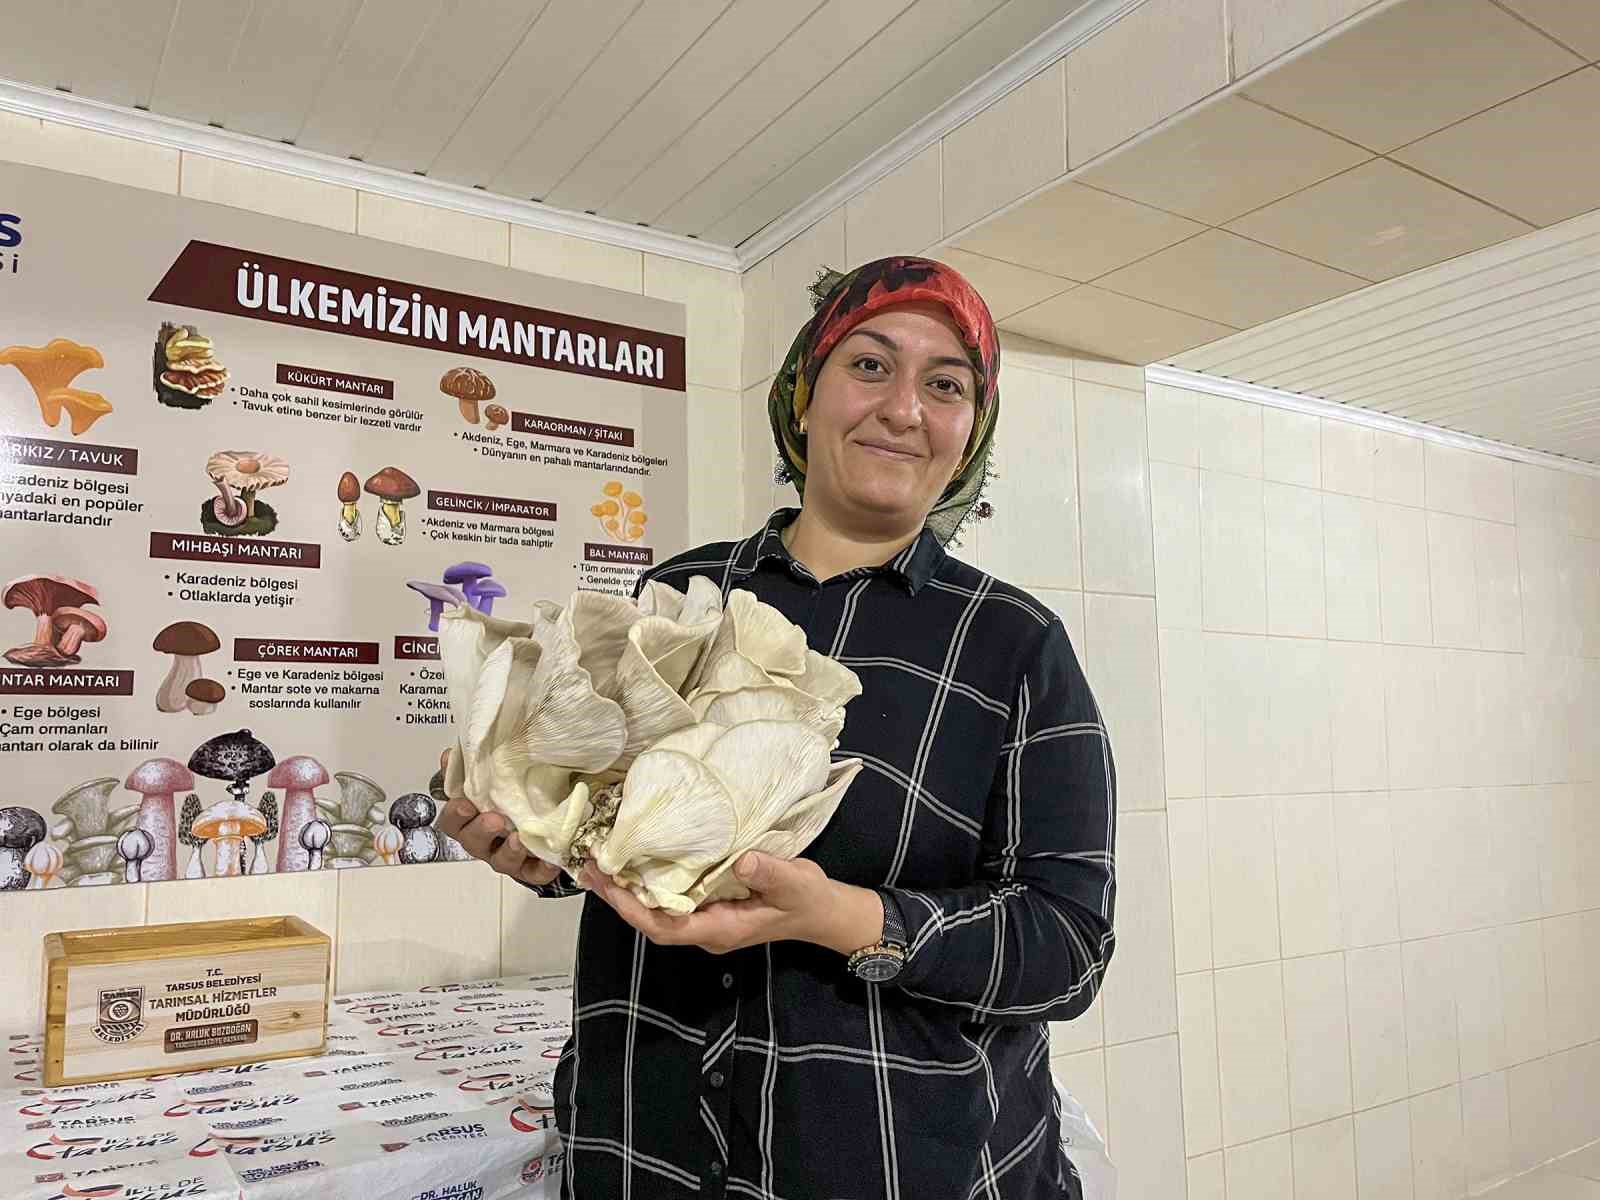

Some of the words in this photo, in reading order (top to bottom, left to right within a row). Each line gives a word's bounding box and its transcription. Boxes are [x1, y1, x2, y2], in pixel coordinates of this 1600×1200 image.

[237, 261, 448, 343] ÜLKEMİZİN
[458, 311, 664, 380] MANTARLARI
[287, 370, 332, 388] KÜKÜRT
[335, 378, 384, 395] MANTARI
[240, 386, 268, 399] Daha
[272, 392, 291, 404] çok
[294, 395, 319, 406] sahil
[322, 398, 386, 416] kesimlerinde
[389, 407, 424, 421] görülür
[242, 400, 273, 413] Tavuk
[277, 405, 302, 417] etine
[306, 408, 341, 422] benzer
[344, 413, 357, 424] bir
[360, 416, 391, 429] lezzeti
[394, 421, 422, 432] vardır
[524, 418, 586, 436] KARAORMAN
[69, 449, 124, 466] TAVUK
[462, 432, 503, 446] Akdeniz,
[507, 437, 528, 449] Ege,
[531, 440, 571, 455] Marmara
[573, 447, 584, 456] ve
[586, 447, 630, 463] Karadeniz
[632, 452, 668, 467] bölgeleri
[481, 447, 527, 462] Dünyanın
[530, 455, 541, 463] en
[544, 455, 571, 468] pahalı
[3, 474, 69, 489] adeniz
[73, 478, 129, 495] bölgesi
[61, 496, 80, 507] en
[85, 498, 144, 512] popüler
[435, 496, 483, 511] GELİNCİK
[492, 500, 550, 517] İMPARATOR
[426, 517, 464, 529] Akdeniz
[480, 522, 520, 534] Marmara
[522, 526, 554, 538] bölgesi
[430, 529, 449, 540] Çok
[452, 532, 482, 543] keskin
[484, 535, 496, 543] bir
[499, 536, 518, 545] tada
[521, 538, 553, 549] sahiptir
[171, 539, 234, 557] MIHBAŞI
[237, 545, 303, 560] MANTARI
[589, 548, 606, 558] BAL
[608, 550, 649, 561] MANTARI
[580, 563, 598, 572] Tüm
[600, 565, 635, 575] ormanlık
[176, 572, 247, 589] Karadeniz
[250, 576, 298, 591] bölgesi
[586, 575, 621, 585] Genelde
[179, 590, 251, 604] Otlaklarda
[254, 593, 295, 609] yetişir
[257, 642, 301, 659] ÇÖREK
[303, 646, 359, 659] MANTARI
[2, 673, 45, 687] NTAR
[49, 674, 120, 687] MANTARI
[237, 669, 262, 683] Ege
[264, 671, 279, 680] ve
[282, 669, 341, 681] Karadeniz
[343, 670, 384, 684] bölgesi
[241, 683, 282, 694] Mantar
[286, 685, 312, 695] sote
[314, 686, 328, 695] ve
[331, 685, 380, 695] makarna
[13, 706, 43, 720] Ege
[47, 706, 101, 720] bölgesi
[249, 698, 311, 709] soslarında
[313, 698, 361, 710] kullanılır
[406, 713, 447, 725] Dikkatli
[0, 723, 34, 738] Çam
[38, 722, 108, 735] ormanları
[48, 739, 92, 752] olarak
[97, 739, 116, 751] da
[120, 738, 159, 751] bilinir
[206, 968, 224, 977] T.C.
[165, 980, 205, 992] TARSUS
[206, 973, 262, 989] BELEDİYESİ
[149, 994, 209, 1010] TARIMSAL
[212, 987, 277, 1003] HİZMETLER
[175, 1002, 251, 1022] MÜDÜRLÜĞÜ
[442, 1180, 478, 1196] HALUK
